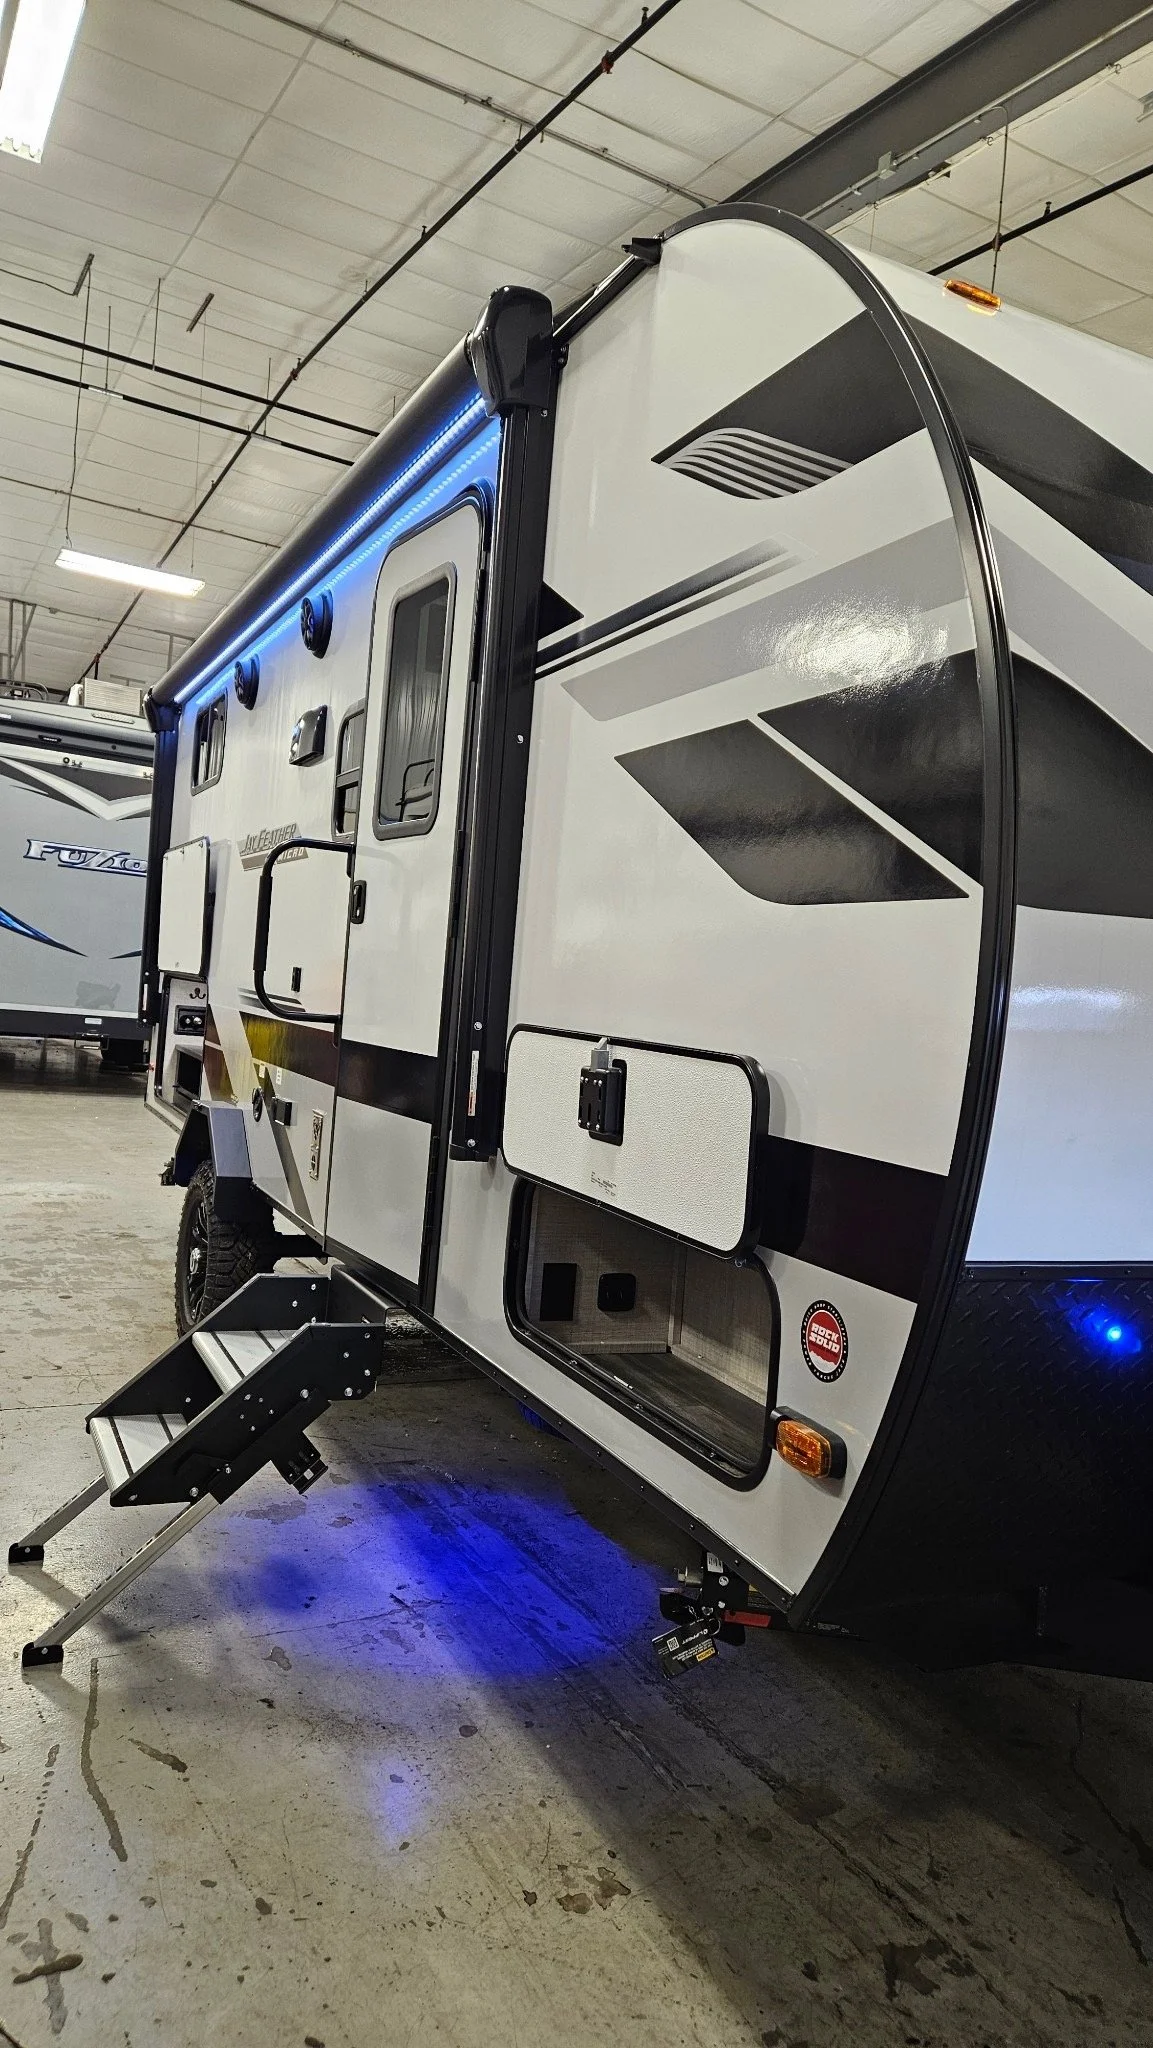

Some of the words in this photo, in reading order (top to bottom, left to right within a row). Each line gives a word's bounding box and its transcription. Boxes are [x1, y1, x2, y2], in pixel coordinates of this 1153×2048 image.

[258, 823, 297, 849] FEATHER
[23, 839, 147, 877] FUZIO
[809, 1332, 840, 1353] SOLID
[811, 1322, 839, 1343] ROCK
